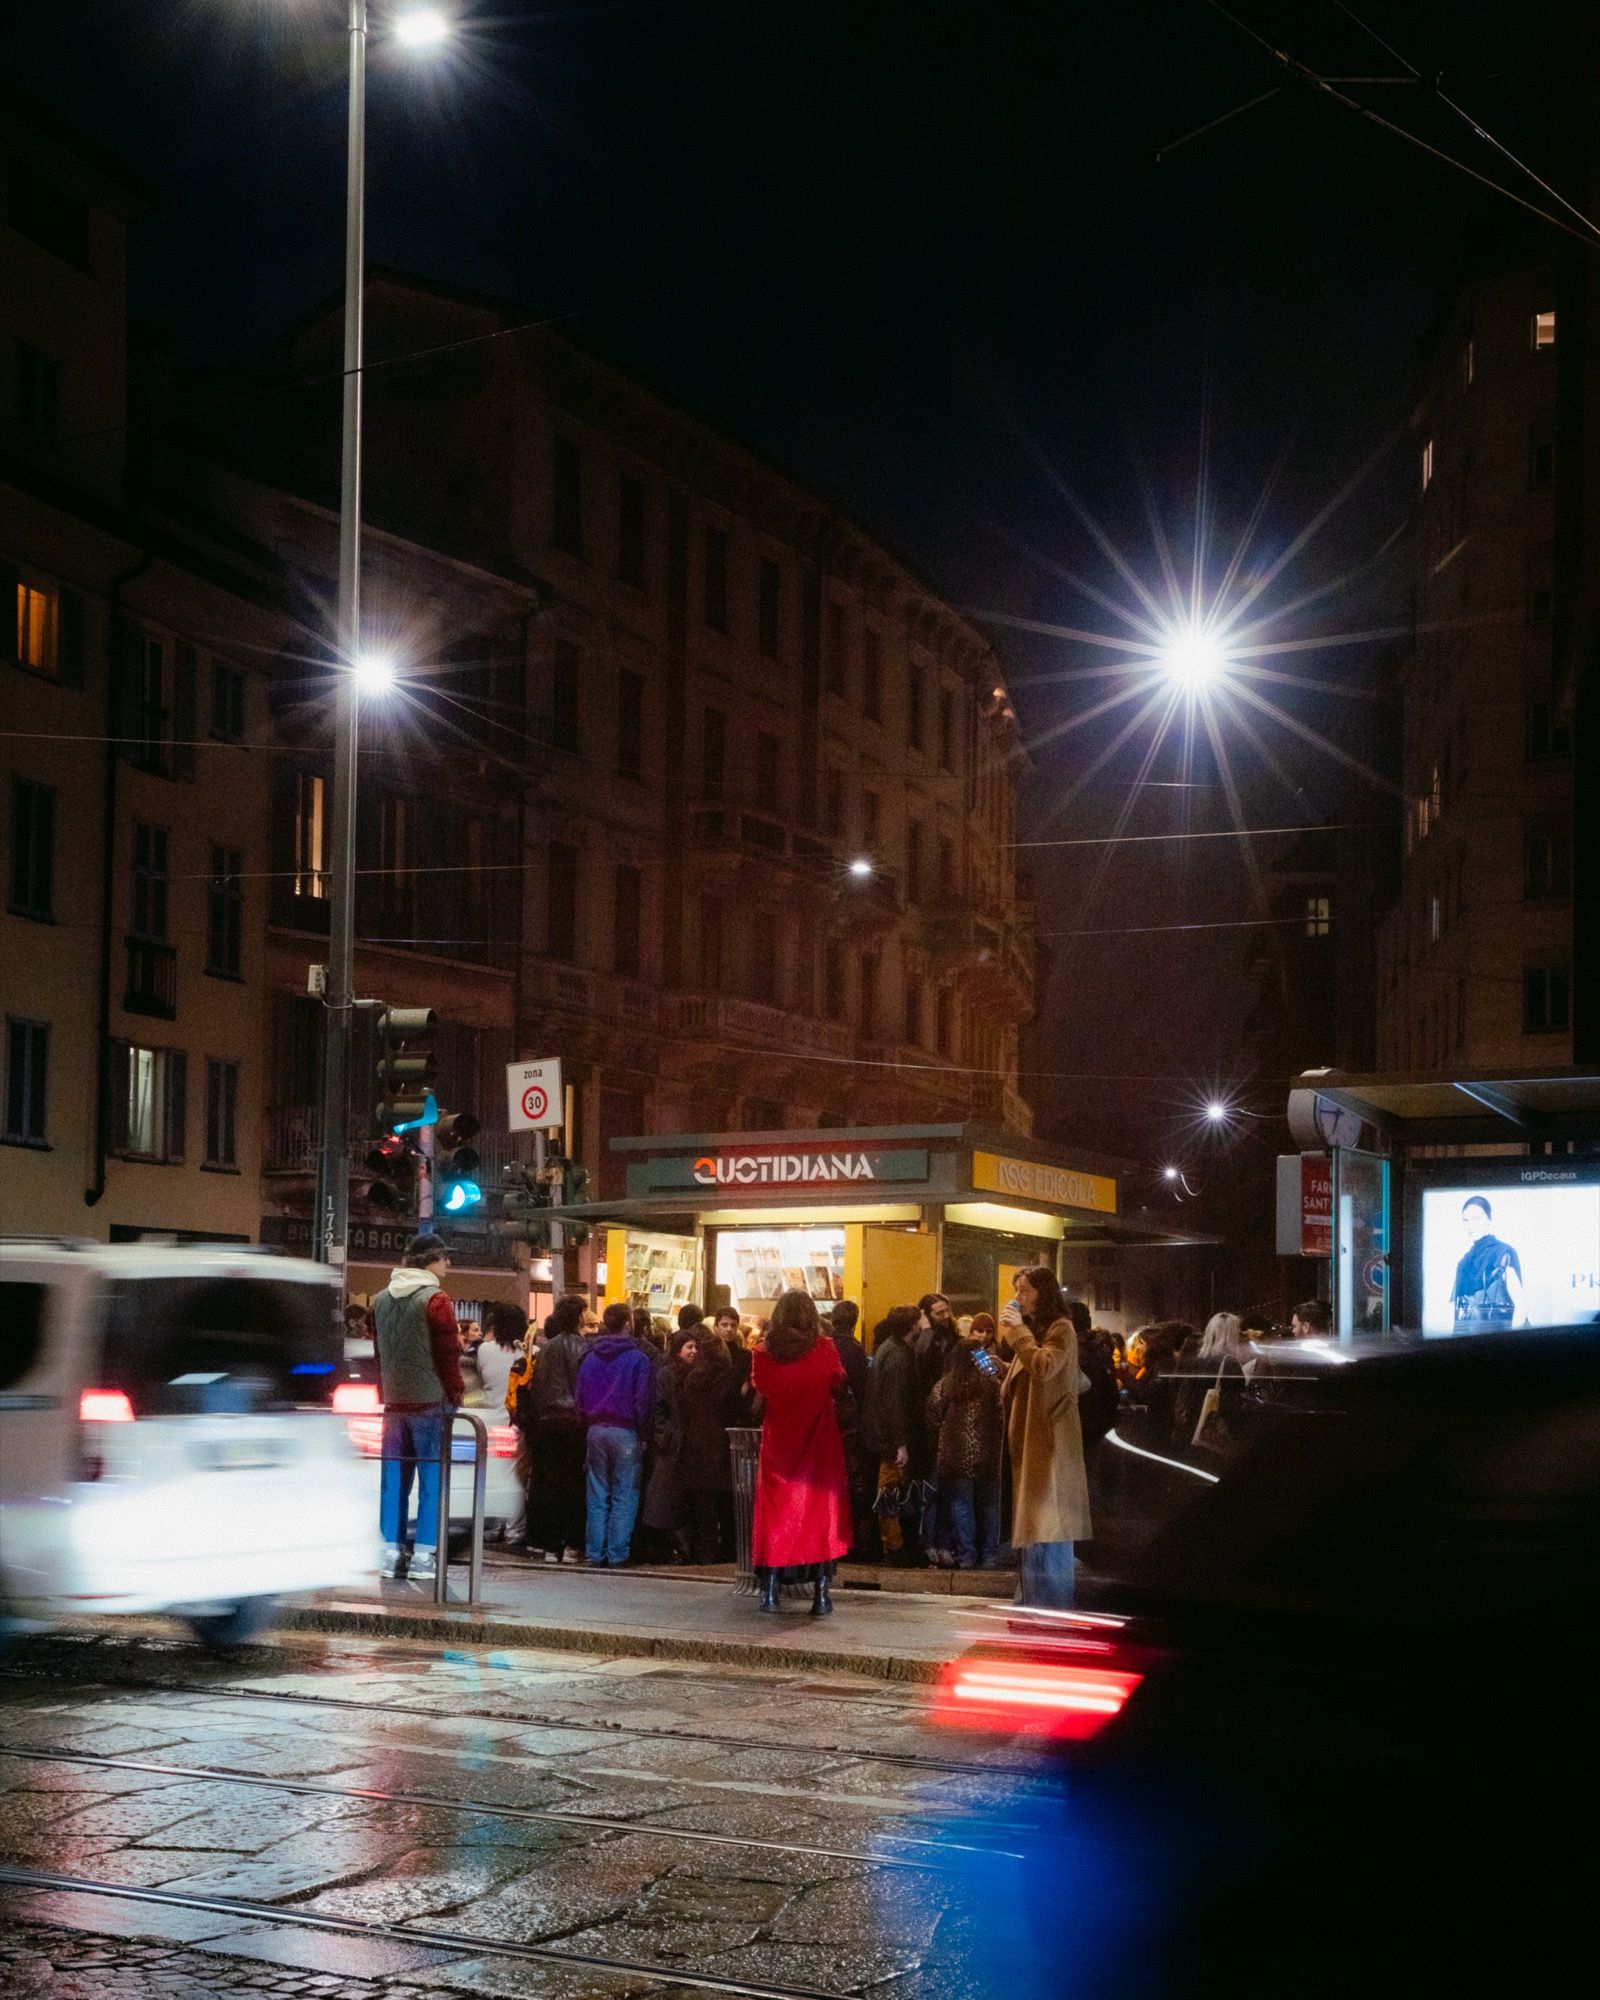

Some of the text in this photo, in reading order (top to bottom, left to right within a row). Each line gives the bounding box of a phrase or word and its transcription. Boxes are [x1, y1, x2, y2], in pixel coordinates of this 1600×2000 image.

[523, 1067, 543, 1080] zona
[528, 1095, 542, 1110] 30
[693, 1152, 875, 1185] QUOTIDIANA
[1520, 1170, 1579, 1182] IGPDecaux
[1034, 1168, 1097, 1204] EDICOLA
[324, 1195, 335, 1248] 172
